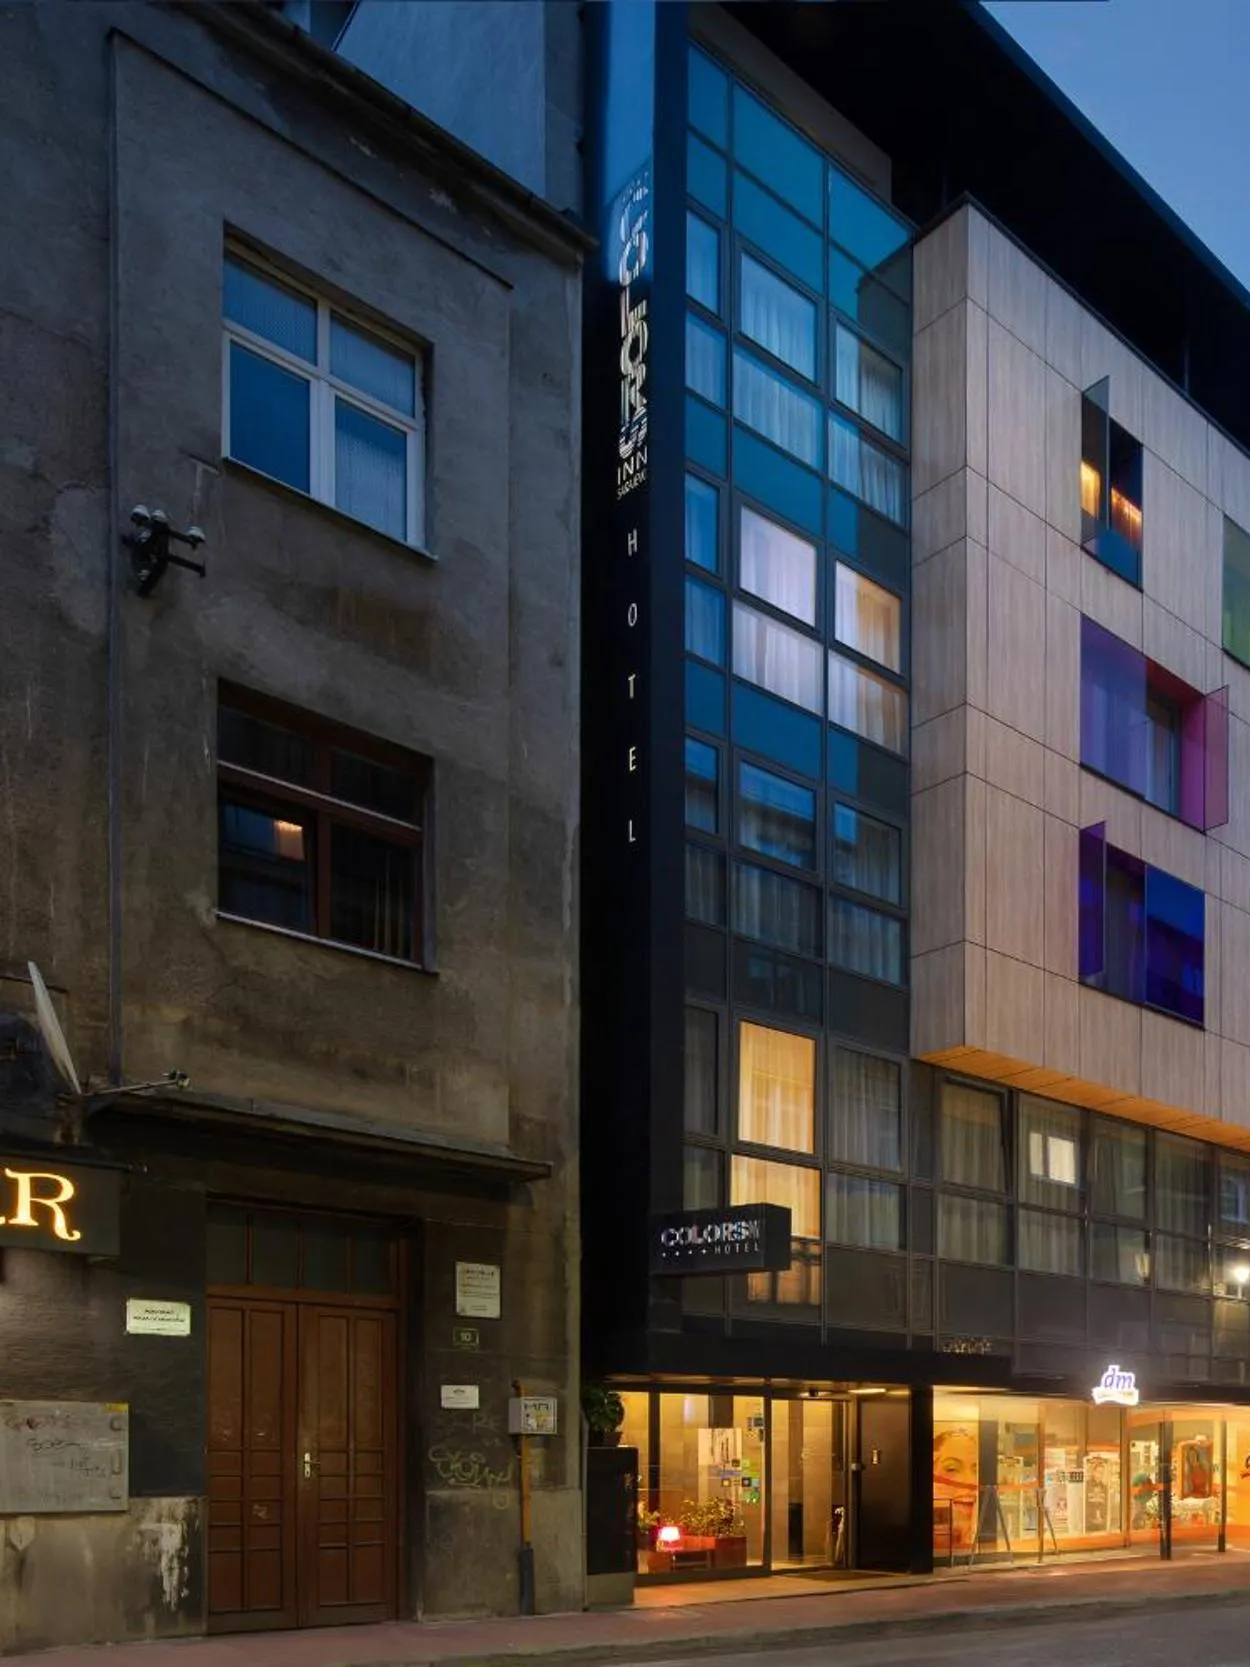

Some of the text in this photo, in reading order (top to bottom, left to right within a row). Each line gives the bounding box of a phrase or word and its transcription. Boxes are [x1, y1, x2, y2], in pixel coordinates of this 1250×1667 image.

[617, 445, 648, 486] INN
[627, 528, 638, 842] HOTEL
[0, 1167, 82, 1241] R
[714, 1241, 760, 1255] HOTEL
[1103, 1367, 1134, 1389] dm
